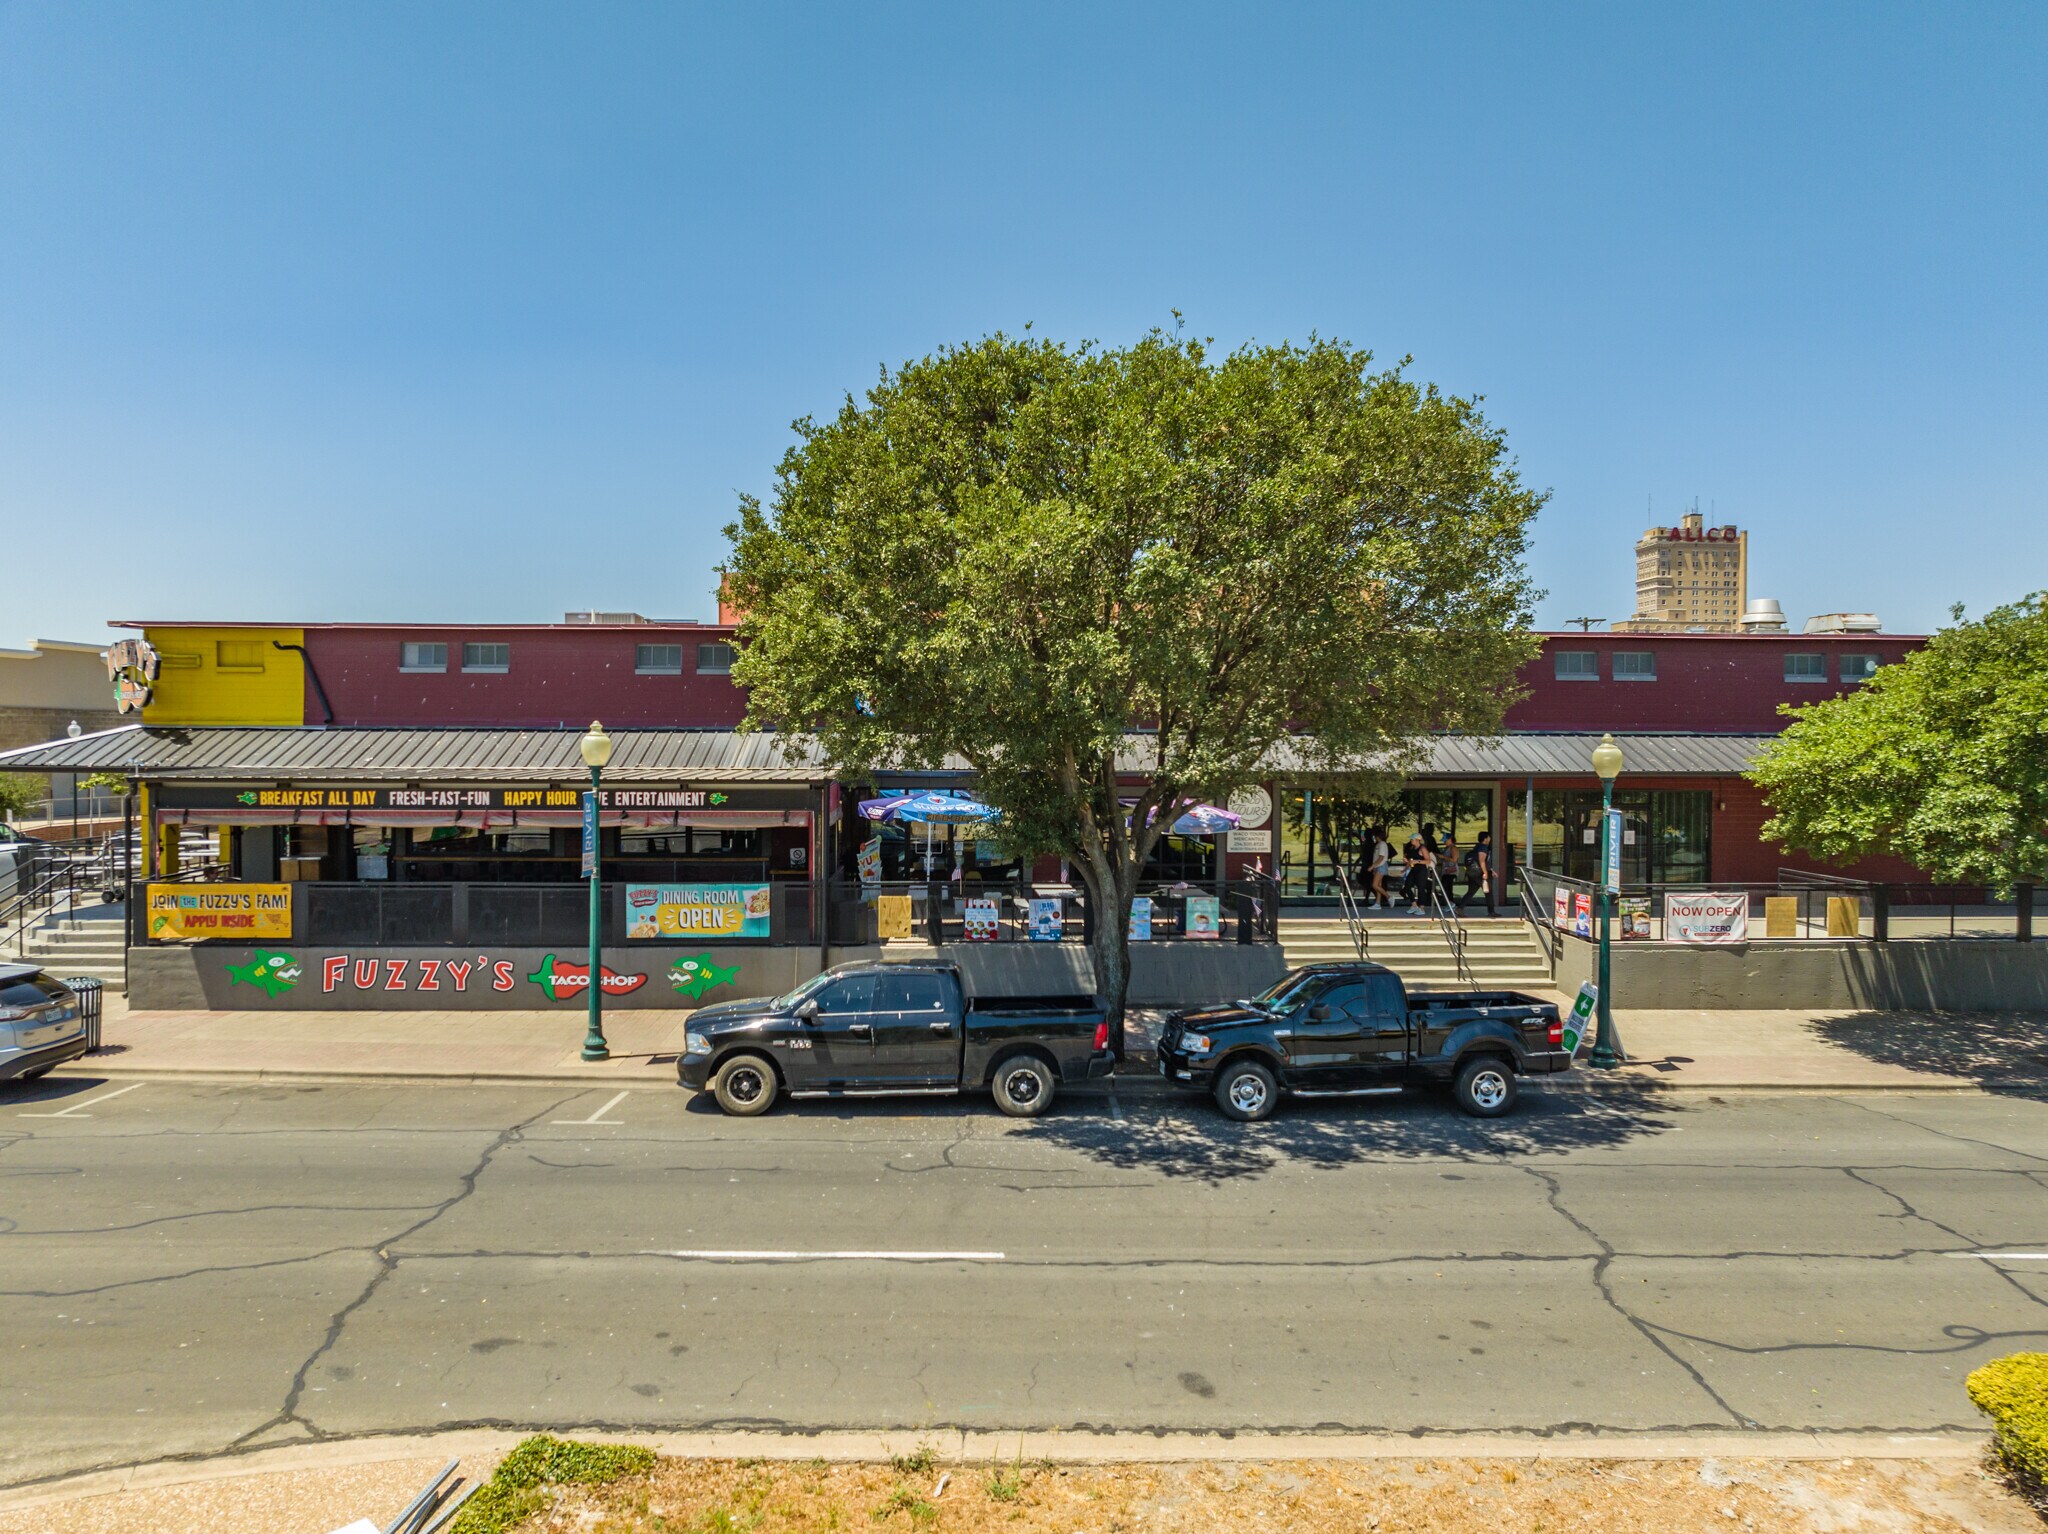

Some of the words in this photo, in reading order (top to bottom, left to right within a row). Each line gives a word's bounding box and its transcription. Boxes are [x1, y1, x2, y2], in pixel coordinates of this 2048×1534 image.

[1668, 527, 1737, 542] ALICO
[259, 791, 324, 806] BREAKFAST
[328, 791, 349, 806] ALL
[353, 791, 376, 806] DAY
[389, 791, 490, 806] FRESH-FAST-FUN
[503, 791, 542, 806] HAPPY
[546, 791, 577, 806] HOUR
[615, 791, 706, 806] ENTERTAINMENT
[1231, 804, 1268, 815] TOURS
[1609, 819, 1617, 867] RIVER
[153, 895, 178, 908] JOIN
[200, 894, 251, 909] FUZZY'S
[256, 895, 287, 909] FAM!
[662, 890, 699, 904] DINING
[703, 890, 739, 904] ROOM
[678, 907, 723, 928] OPEN
[1672, 906, 1703, 917] NOW
[1706, 906, 1741, 917] OPEN
[185, 915, 217, 928] APPLY
[221, 914, 255, 928] INSIDE
[1693, 925, 1731, 933] SUBZERO
[322, 953, 515, 993] FUZZY'S
[550, 974, 589, 986] TACO
